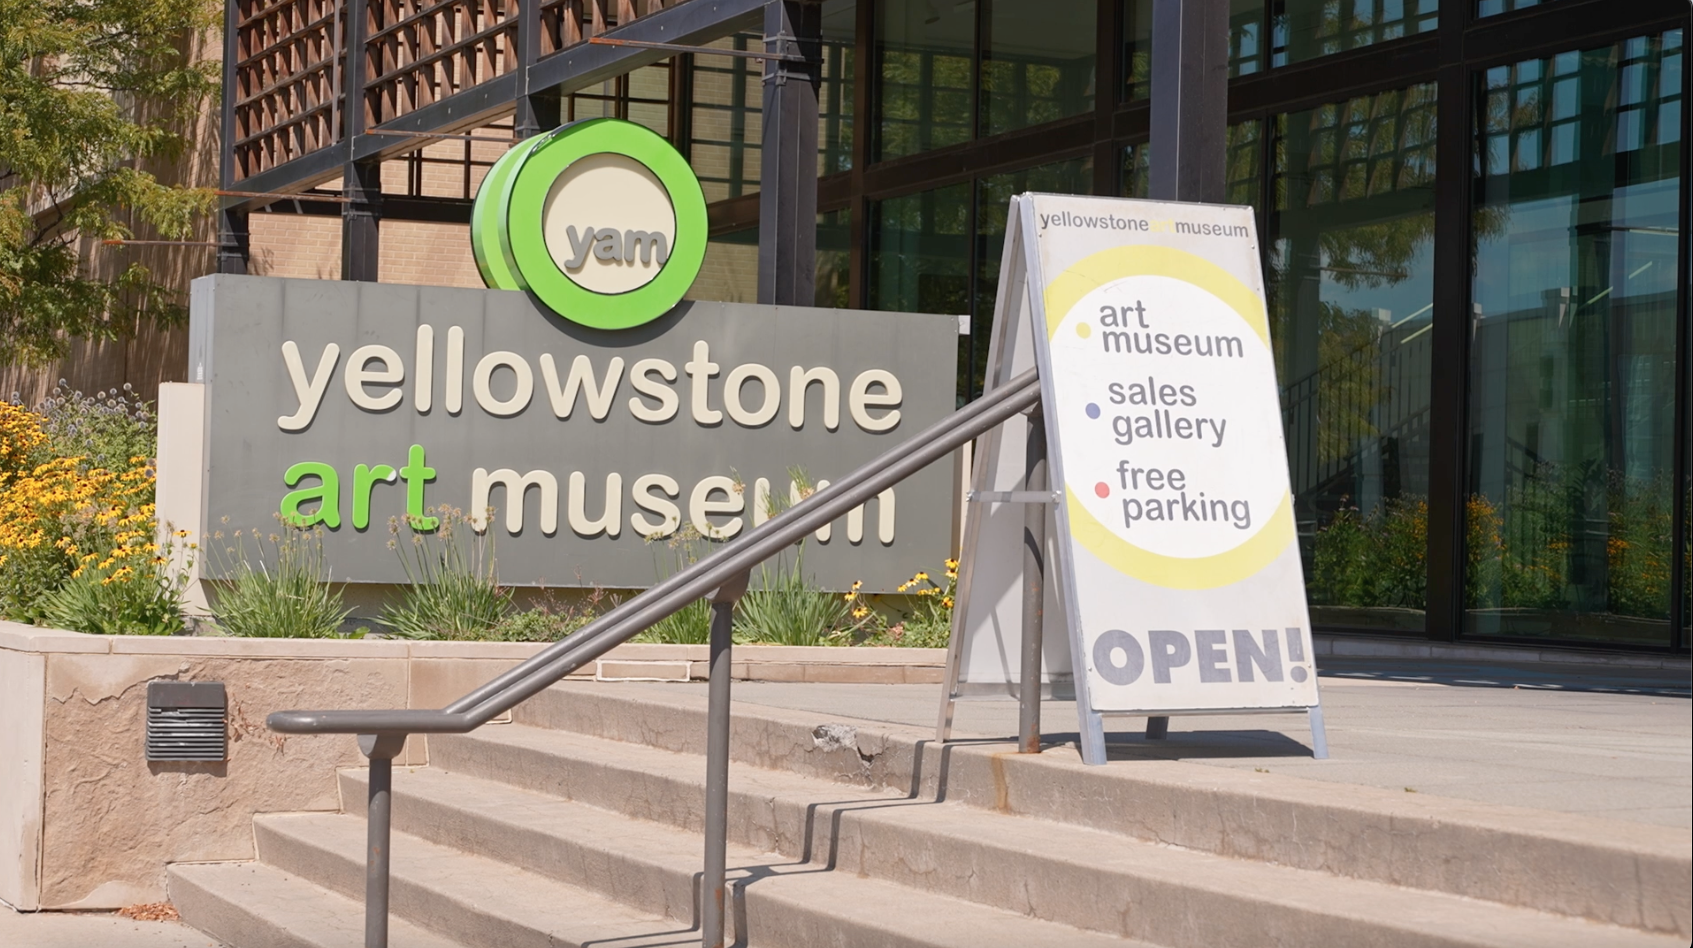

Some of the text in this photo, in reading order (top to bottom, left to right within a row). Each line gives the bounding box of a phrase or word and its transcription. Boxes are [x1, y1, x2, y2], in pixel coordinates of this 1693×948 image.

[563, 225, 668, 269] yam
[1099, 300, 1150, 329] art
[1102, 331, 1244, 358] museum
[277, 324, 903, 432] yellowstone
[1108, 376, 1198, 407] sales
[1112, 409, 1227, 448] gallery
[280, 444, 440, 530] art
[1116, 460, 1187, 491] free
[1122, 491, 1252, 530] parking
[1092, 627, 1308, 686] OPEN!
